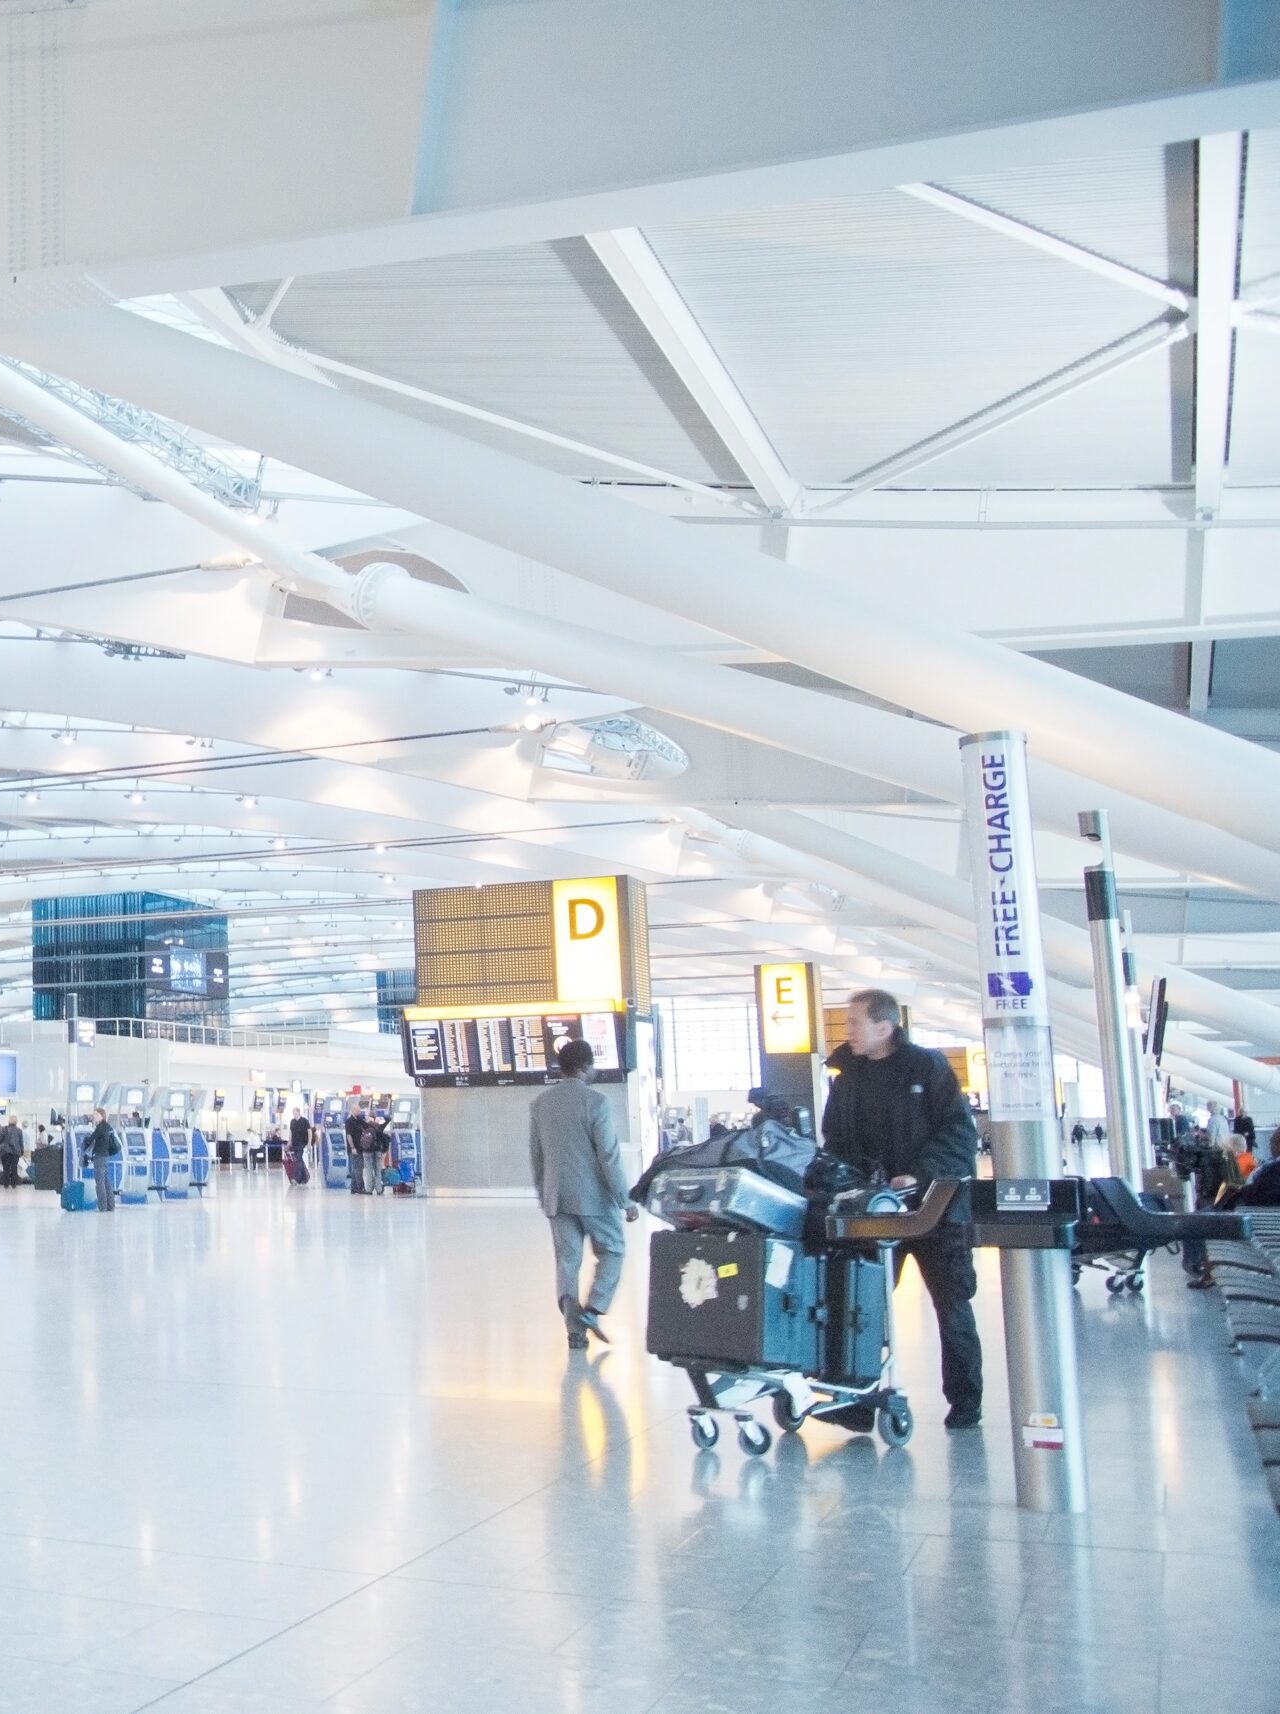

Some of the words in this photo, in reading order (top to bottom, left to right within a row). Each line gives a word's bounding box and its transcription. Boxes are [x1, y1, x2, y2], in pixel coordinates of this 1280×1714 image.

[981, 754, 1014, 873] CHARGE
[568, 898, 605, 940] D
[992, 890, 1020, 957] FREE
[775, 976, 794, 1004] E
[995, 998, 1028, 1010] FREE
